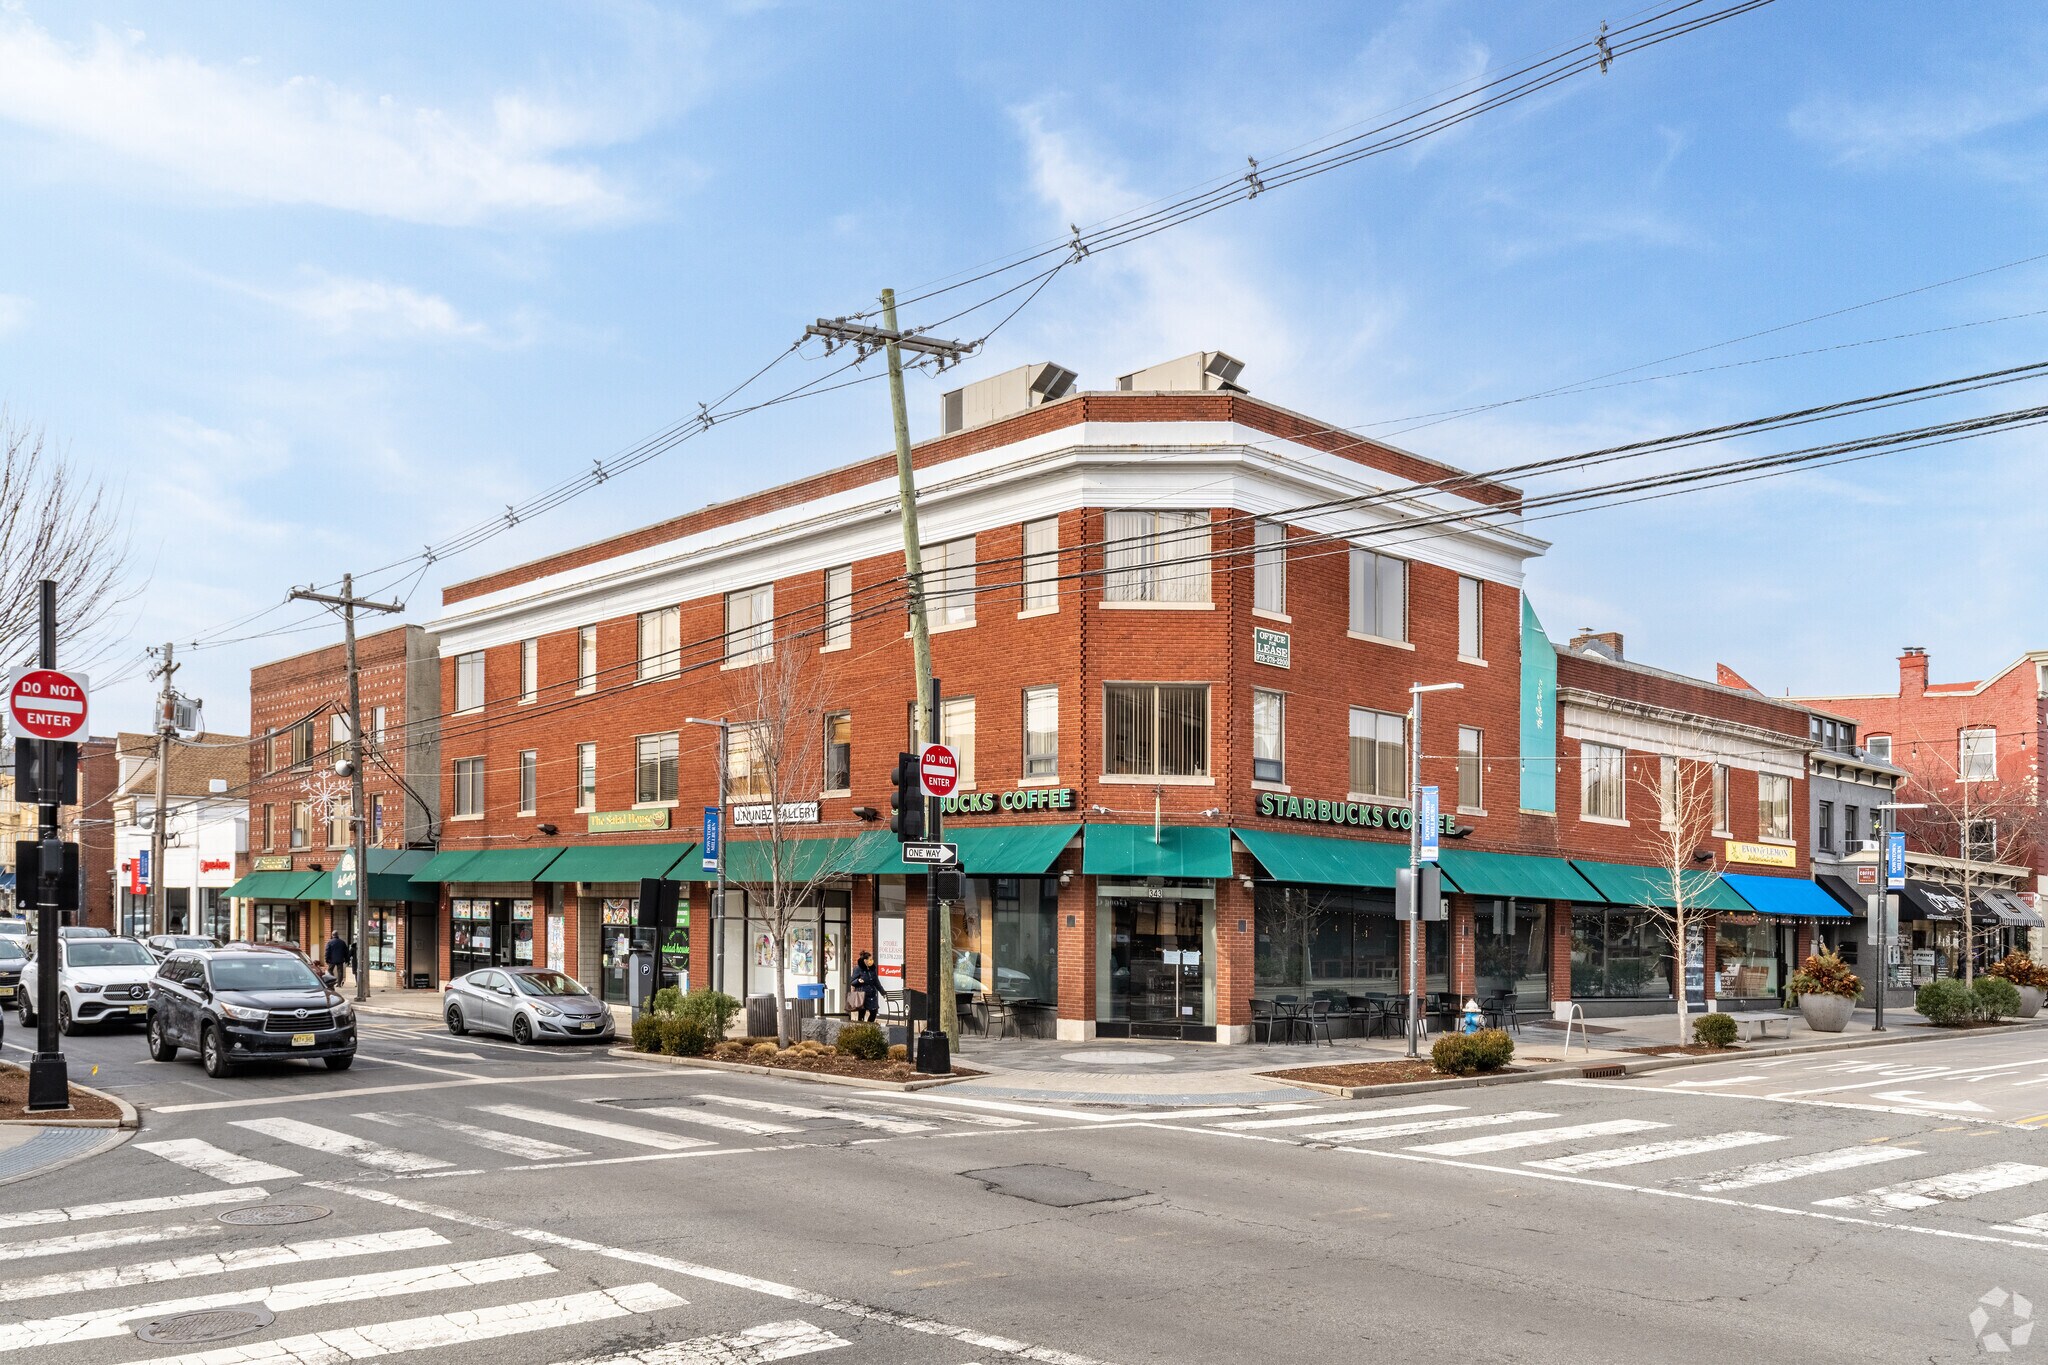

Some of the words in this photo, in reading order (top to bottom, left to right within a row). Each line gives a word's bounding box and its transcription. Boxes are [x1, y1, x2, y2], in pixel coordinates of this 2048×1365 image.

[1260, 631, 1286, 644] OFFICE
[1257, 643, 1288, 658] LEASE
[22, 681, 42, 694] DO
[50, 684, 77, 698] NOT
[27, 712, 71, 727] ENTER
[926, 753, 936, 763] DO
[939, 755, 952, 765] NOT
[928, 777, 950, 787] ENTER
[1000, 788, 1071, 810] COFFEE
[1261, 792, 1384, 828] STARBUCKS
[590, 816, 605, 826] The
[606, 814, 626, 825] Salad
[628, 813, 653, 824] House
[908, 848, 923, 857] ONE
[925, 849, 941, 857] WAY
[1766, 847, 1788, 857] LEMON
[1149, 889, 1162, 898] 343
